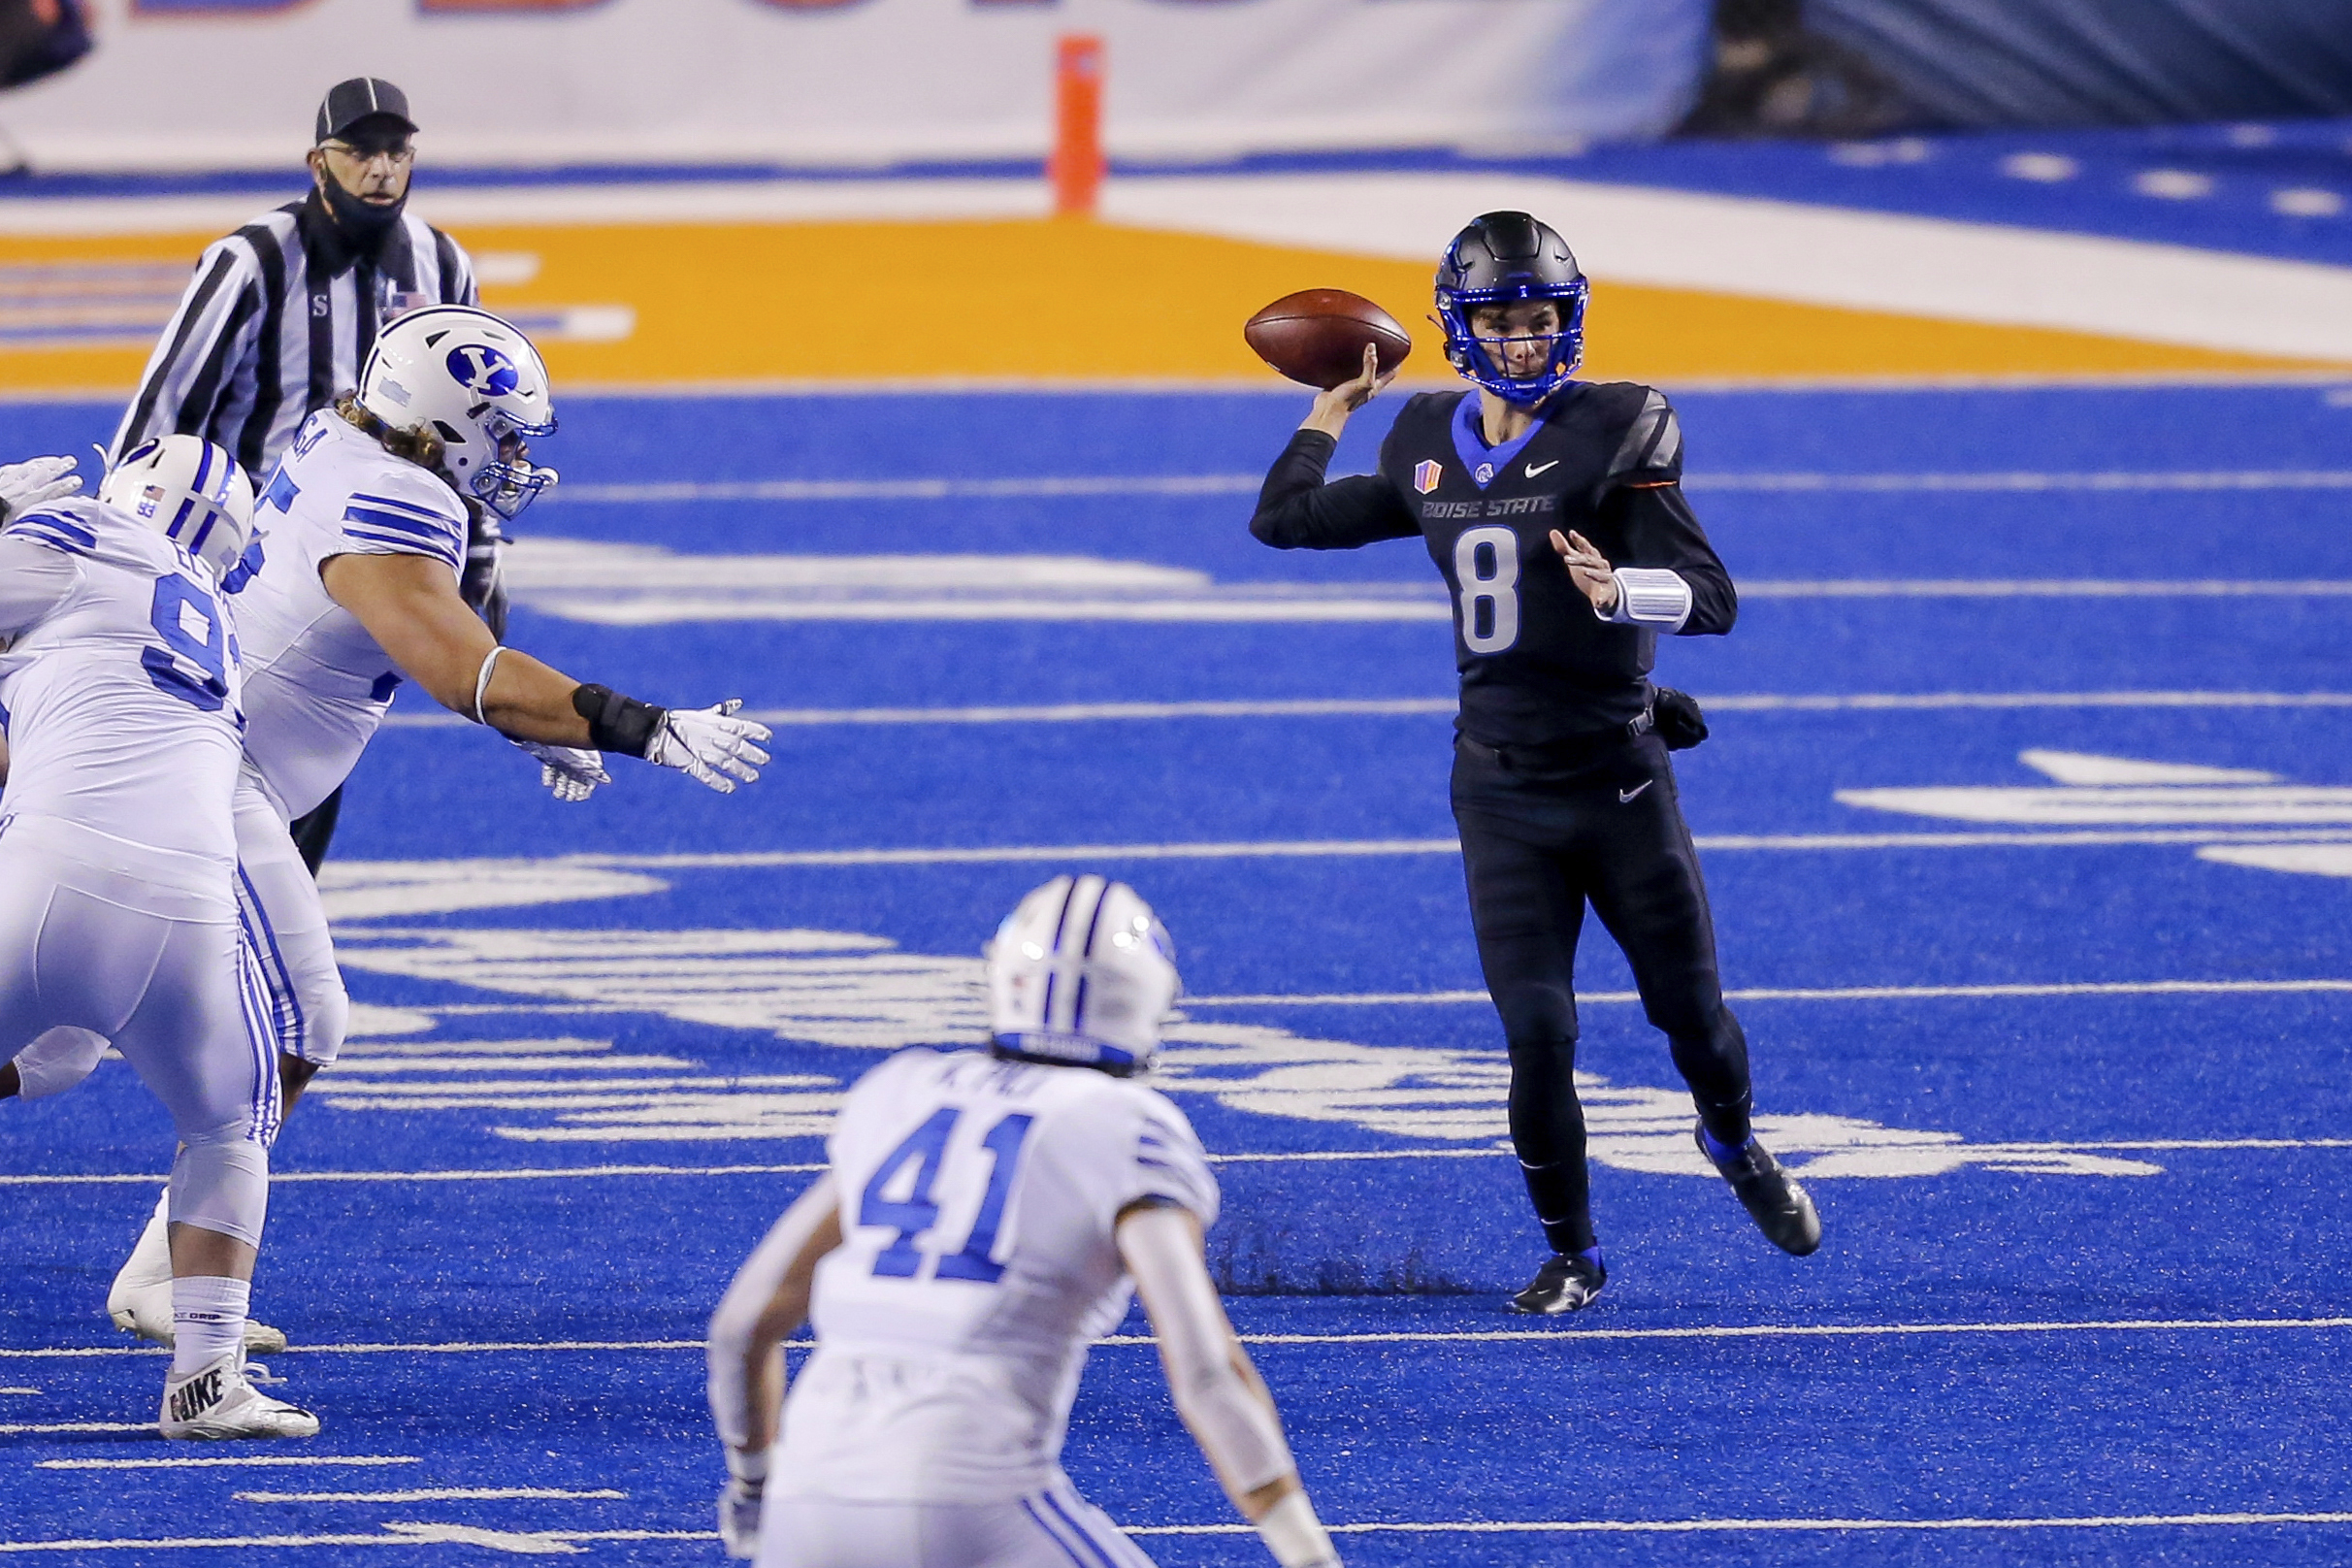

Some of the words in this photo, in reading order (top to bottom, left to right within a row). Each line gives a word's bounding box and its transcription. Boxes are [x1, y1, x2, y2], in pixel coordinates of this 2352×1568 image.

[312, 294, 329, 317] S
[1421, 501, 1483, 519] BOISE
[1486, 495, 1557, 516] STATE
[1454, 523, 1521, 657] 8
[859, 1107, 1034, 1283] 41
[170, 1366, 223, 1422] NIKE
